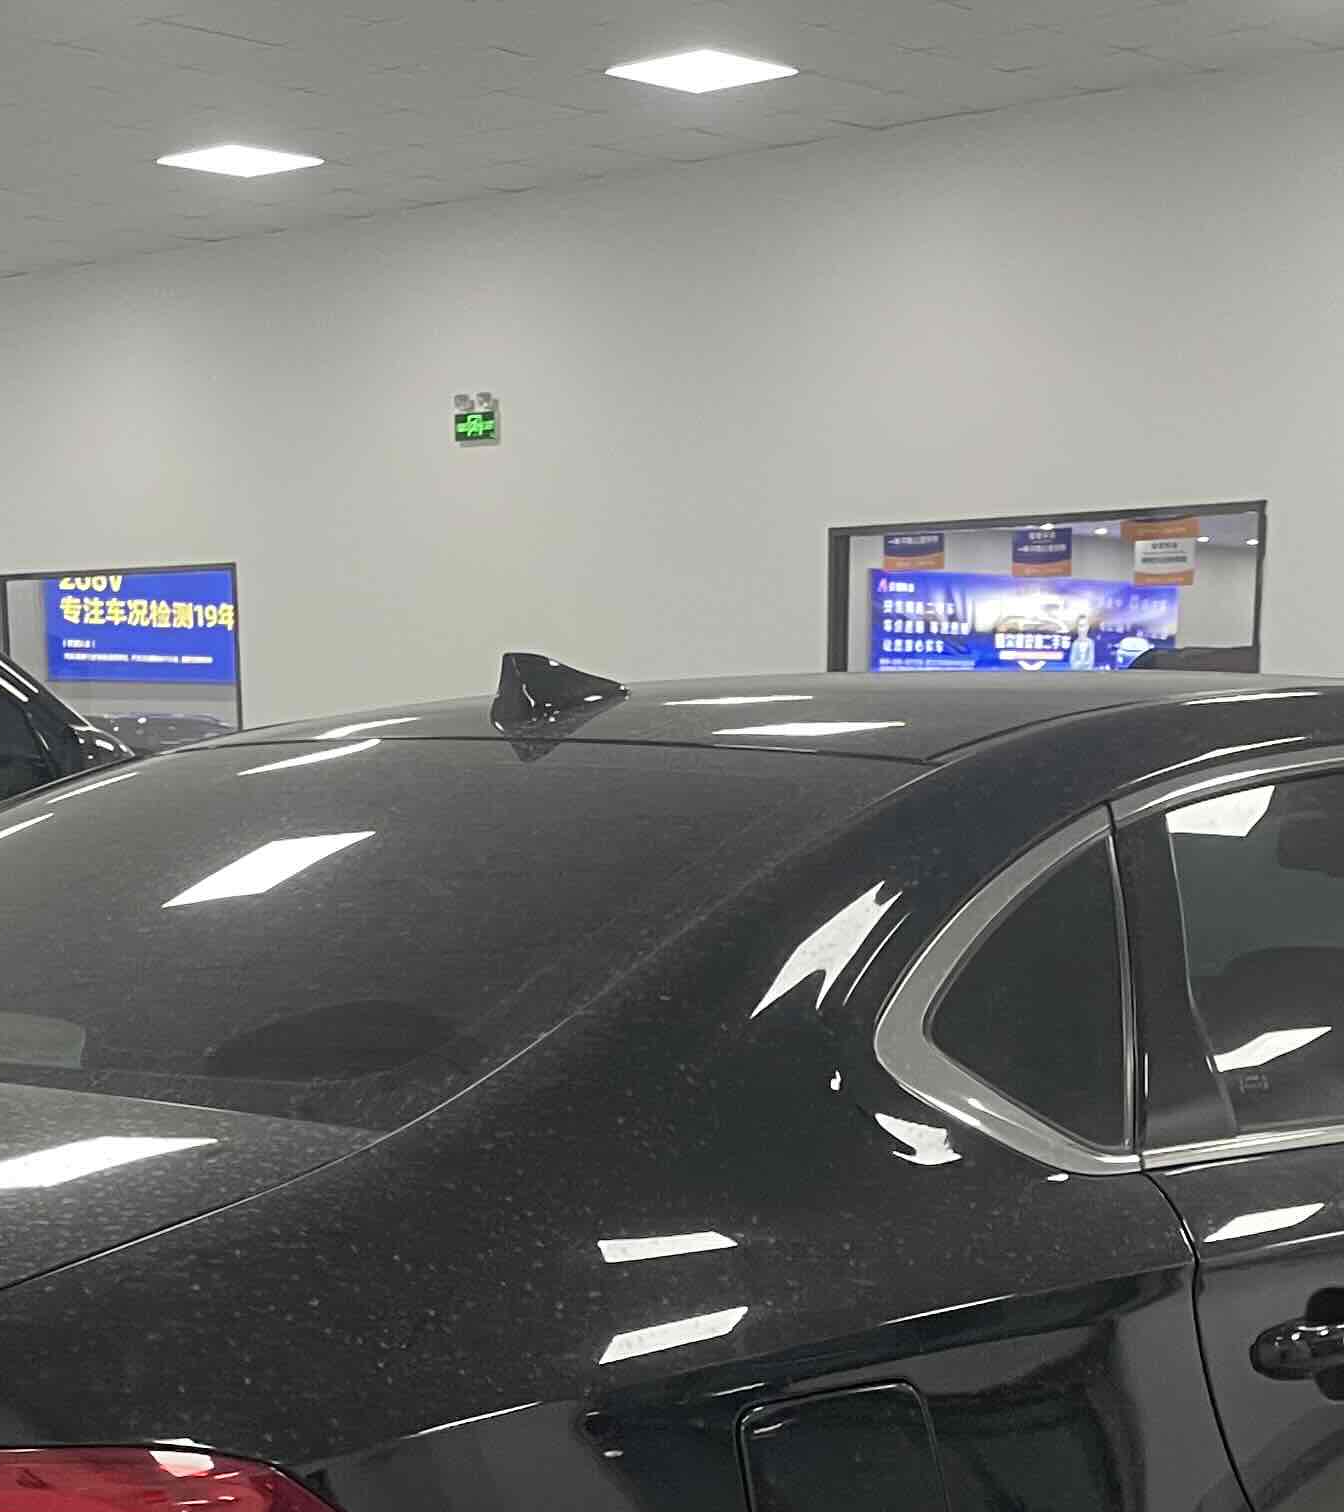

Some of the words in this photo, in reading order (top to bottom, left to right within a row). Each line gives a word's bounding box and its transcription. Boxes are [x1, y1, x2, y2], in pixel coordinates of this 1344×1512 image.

[59, 595, 235, 631] 专注车况检测19年
